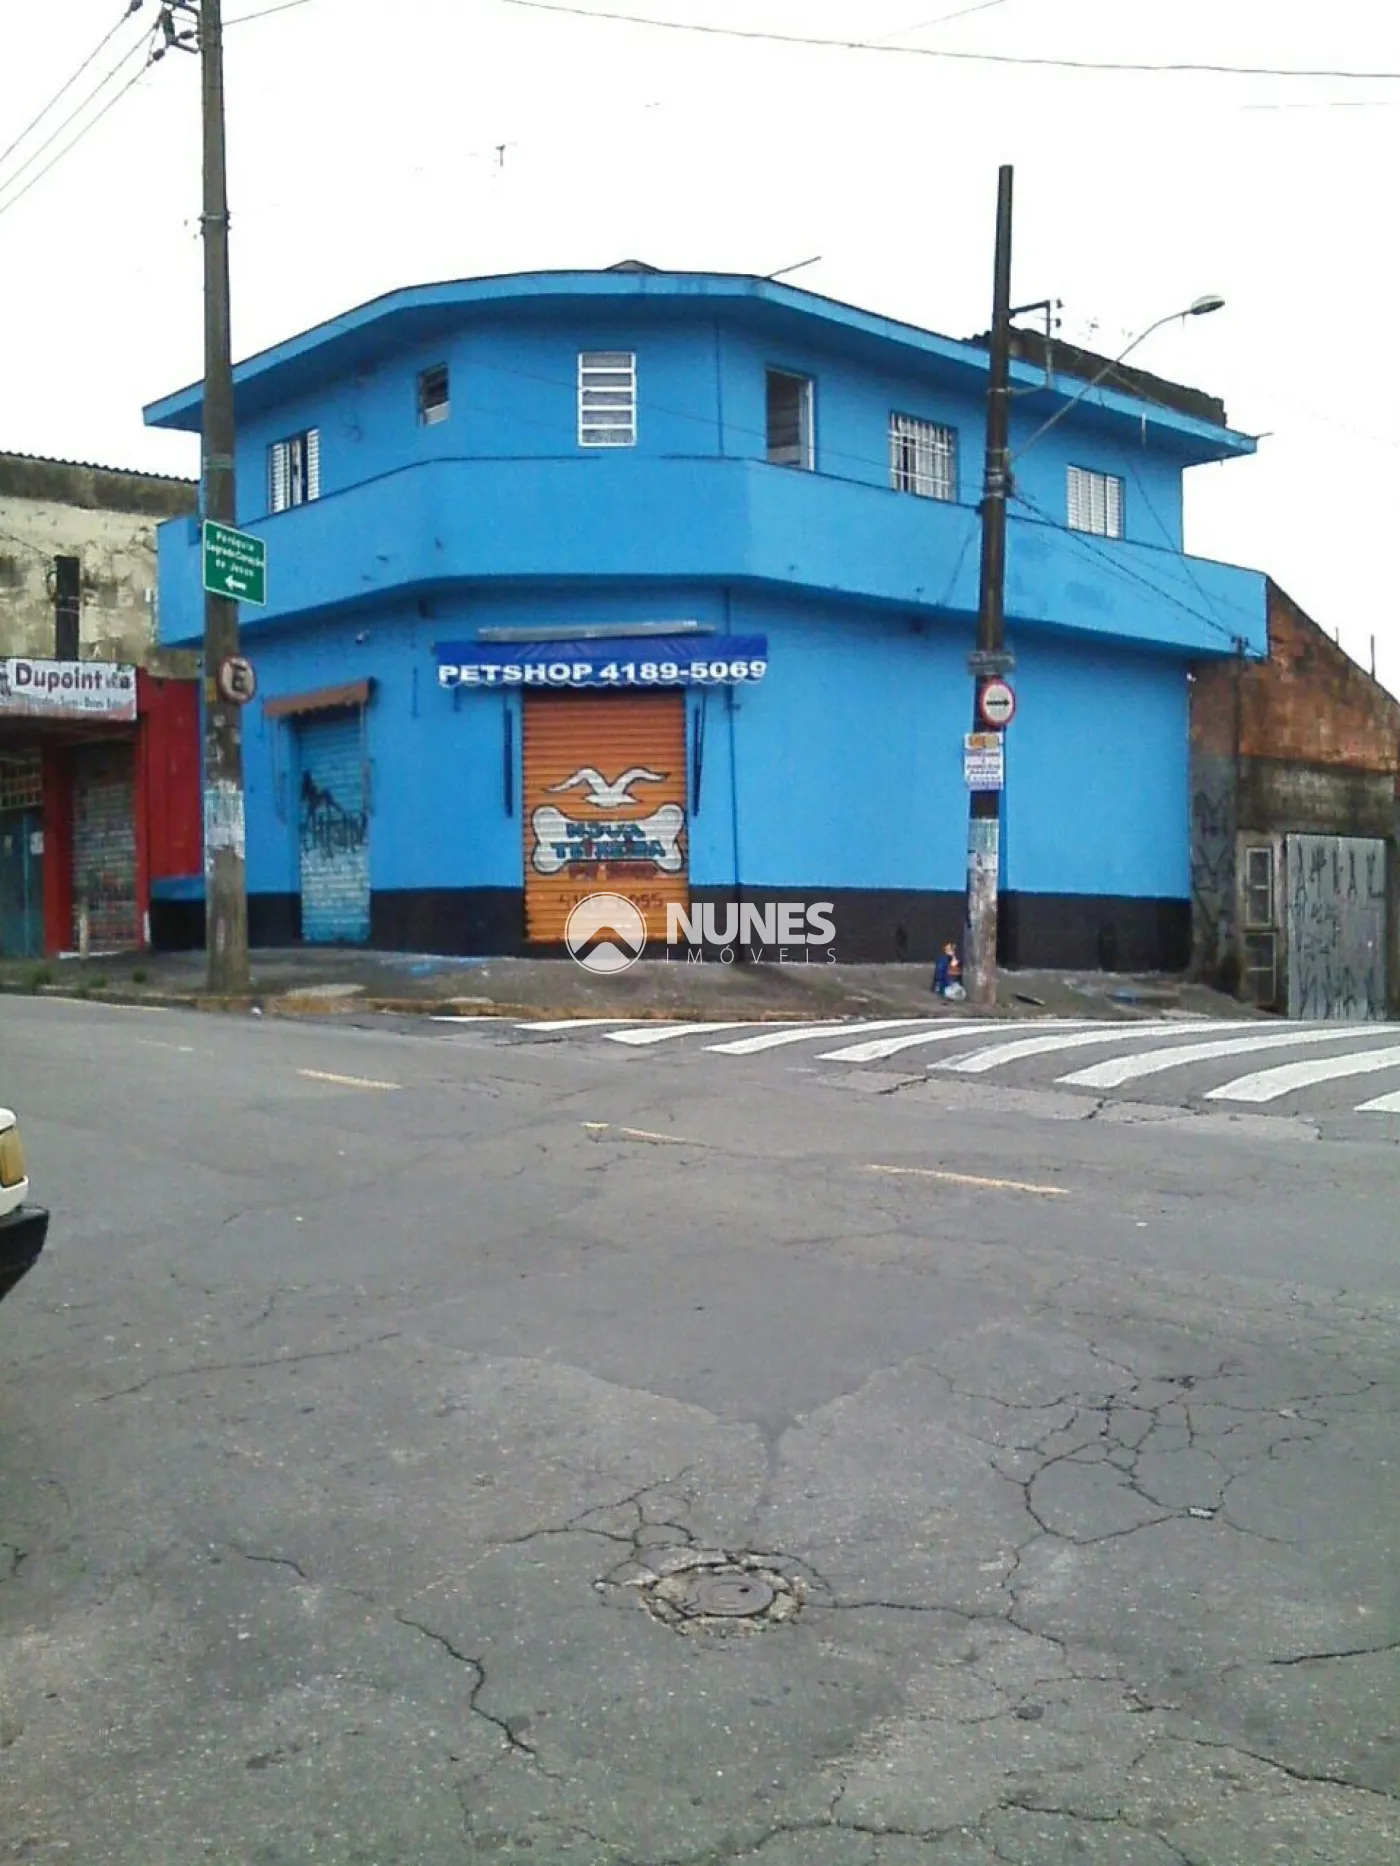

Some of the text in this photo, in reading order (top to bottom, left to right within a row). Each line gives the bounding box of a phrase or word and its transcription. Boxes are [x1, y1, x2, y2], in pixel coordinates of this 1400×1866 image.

[15, 662, 102, 693] Dupoint
[438, 661, 767, 683] PETSHOP 4189-5069
